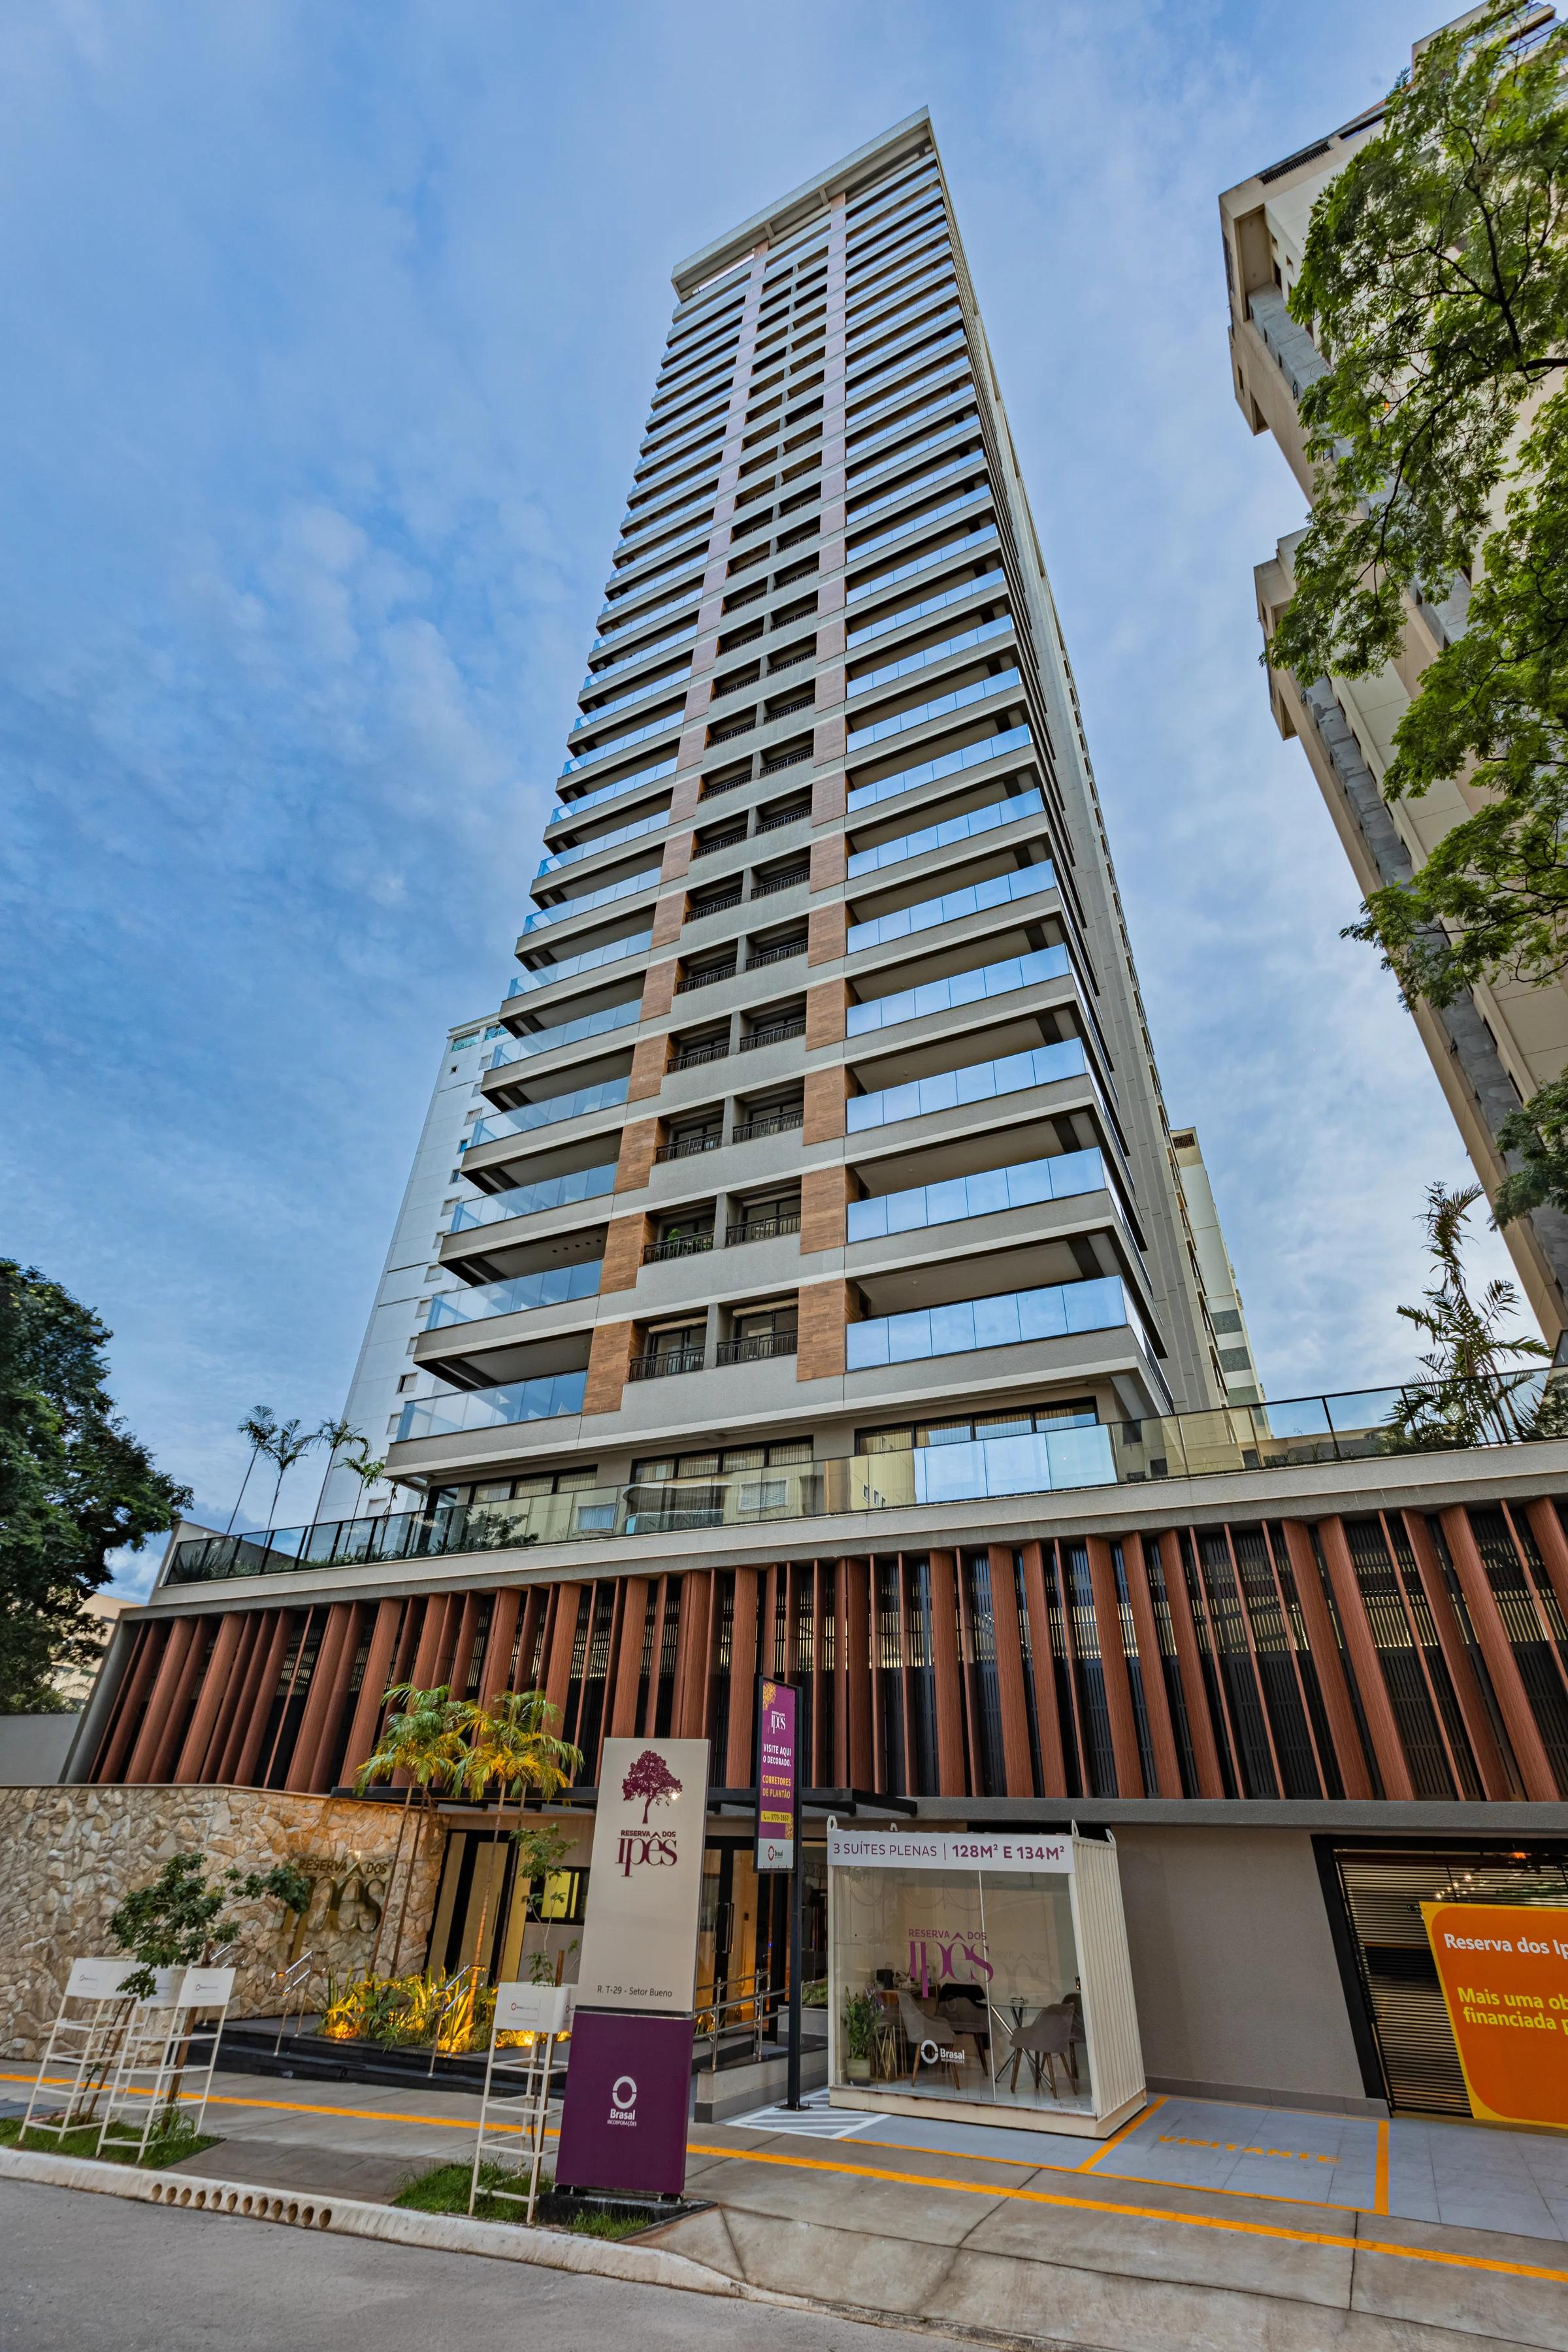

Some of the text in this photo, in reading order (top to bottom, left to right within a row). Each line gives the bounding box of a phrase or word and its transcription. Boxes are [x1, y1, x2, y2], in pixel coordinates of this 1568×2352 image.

[763, 1743, 791, 1757] VISITE AQUI
[762, 1755, 791, 1767] O DECORADO.
[762, 1774, 791, 1787] CORRETORES
[762, 1788, 791, 1799] DE PLANTÃO
[833, 1843, 840, 1854] 3
[843, 1841, 886, 1855] SUÍTES
[889, 1844, 937, 1857] PLENAS
[1003, 1846, 1013, 1859] E
[298, 1859, 388, 1874] RESERVA DOS
[909, 1929, 987, 1940] RESERVA DOS
[1443, 1933, 1512, 1952] Reserva
[1517, 1936, 1550, 1954] dos
[597, 1985, 604, 1993] R.
[606, 1985, 622, 1995] T-29
[629, 1987, 648, 1996] Setor
[649, 1988, 672, 1997] Bueno
[1457, 1987, 1500, 2005] Mais
[1504, 1994, 1544, 2008] uma
[1463, 2006, 1557, 2030] financiada
[940, 2048, 965, 2060] Brasal
[610, 2108, 636, 2121] Brasal
[1158, 2135, 1341, 2164] VISITANTE
